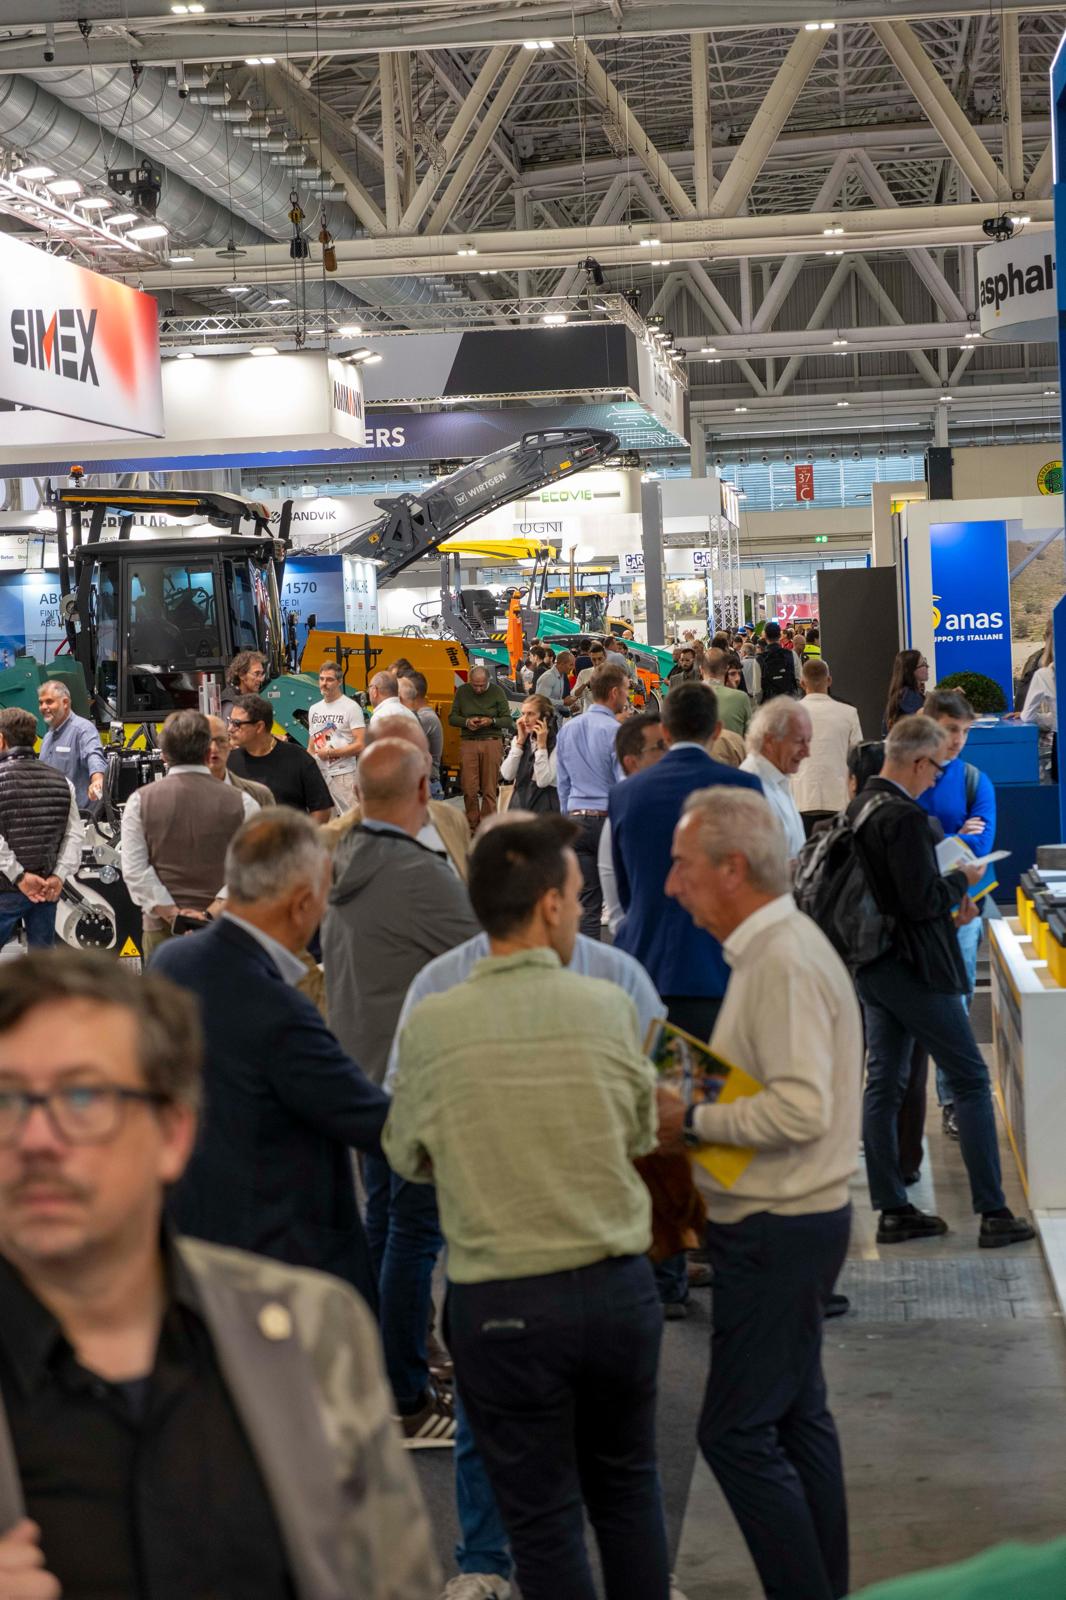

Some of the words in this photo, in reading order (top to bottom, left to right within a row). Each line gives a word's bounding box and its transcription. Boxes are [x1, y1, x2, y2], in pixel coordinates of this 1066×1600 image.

[980, 254, 1056, 311] asphal
[10, 308, 100, 388] SIMEX
[467, 472, 507, 498] WIRTGEN
[798, 473, 811, 484] 37
[541, 489, 592, 503] ECOVIE
[800, 487, 811, 501] C
[289, 510, 337, 521] ANDVIK
[285, 581, 317, 594] 1570
[778, 604, 799, 620] 32
[945, 611, 1004, 631] anas
[967, 633, 1004, 641] ITALIANE
